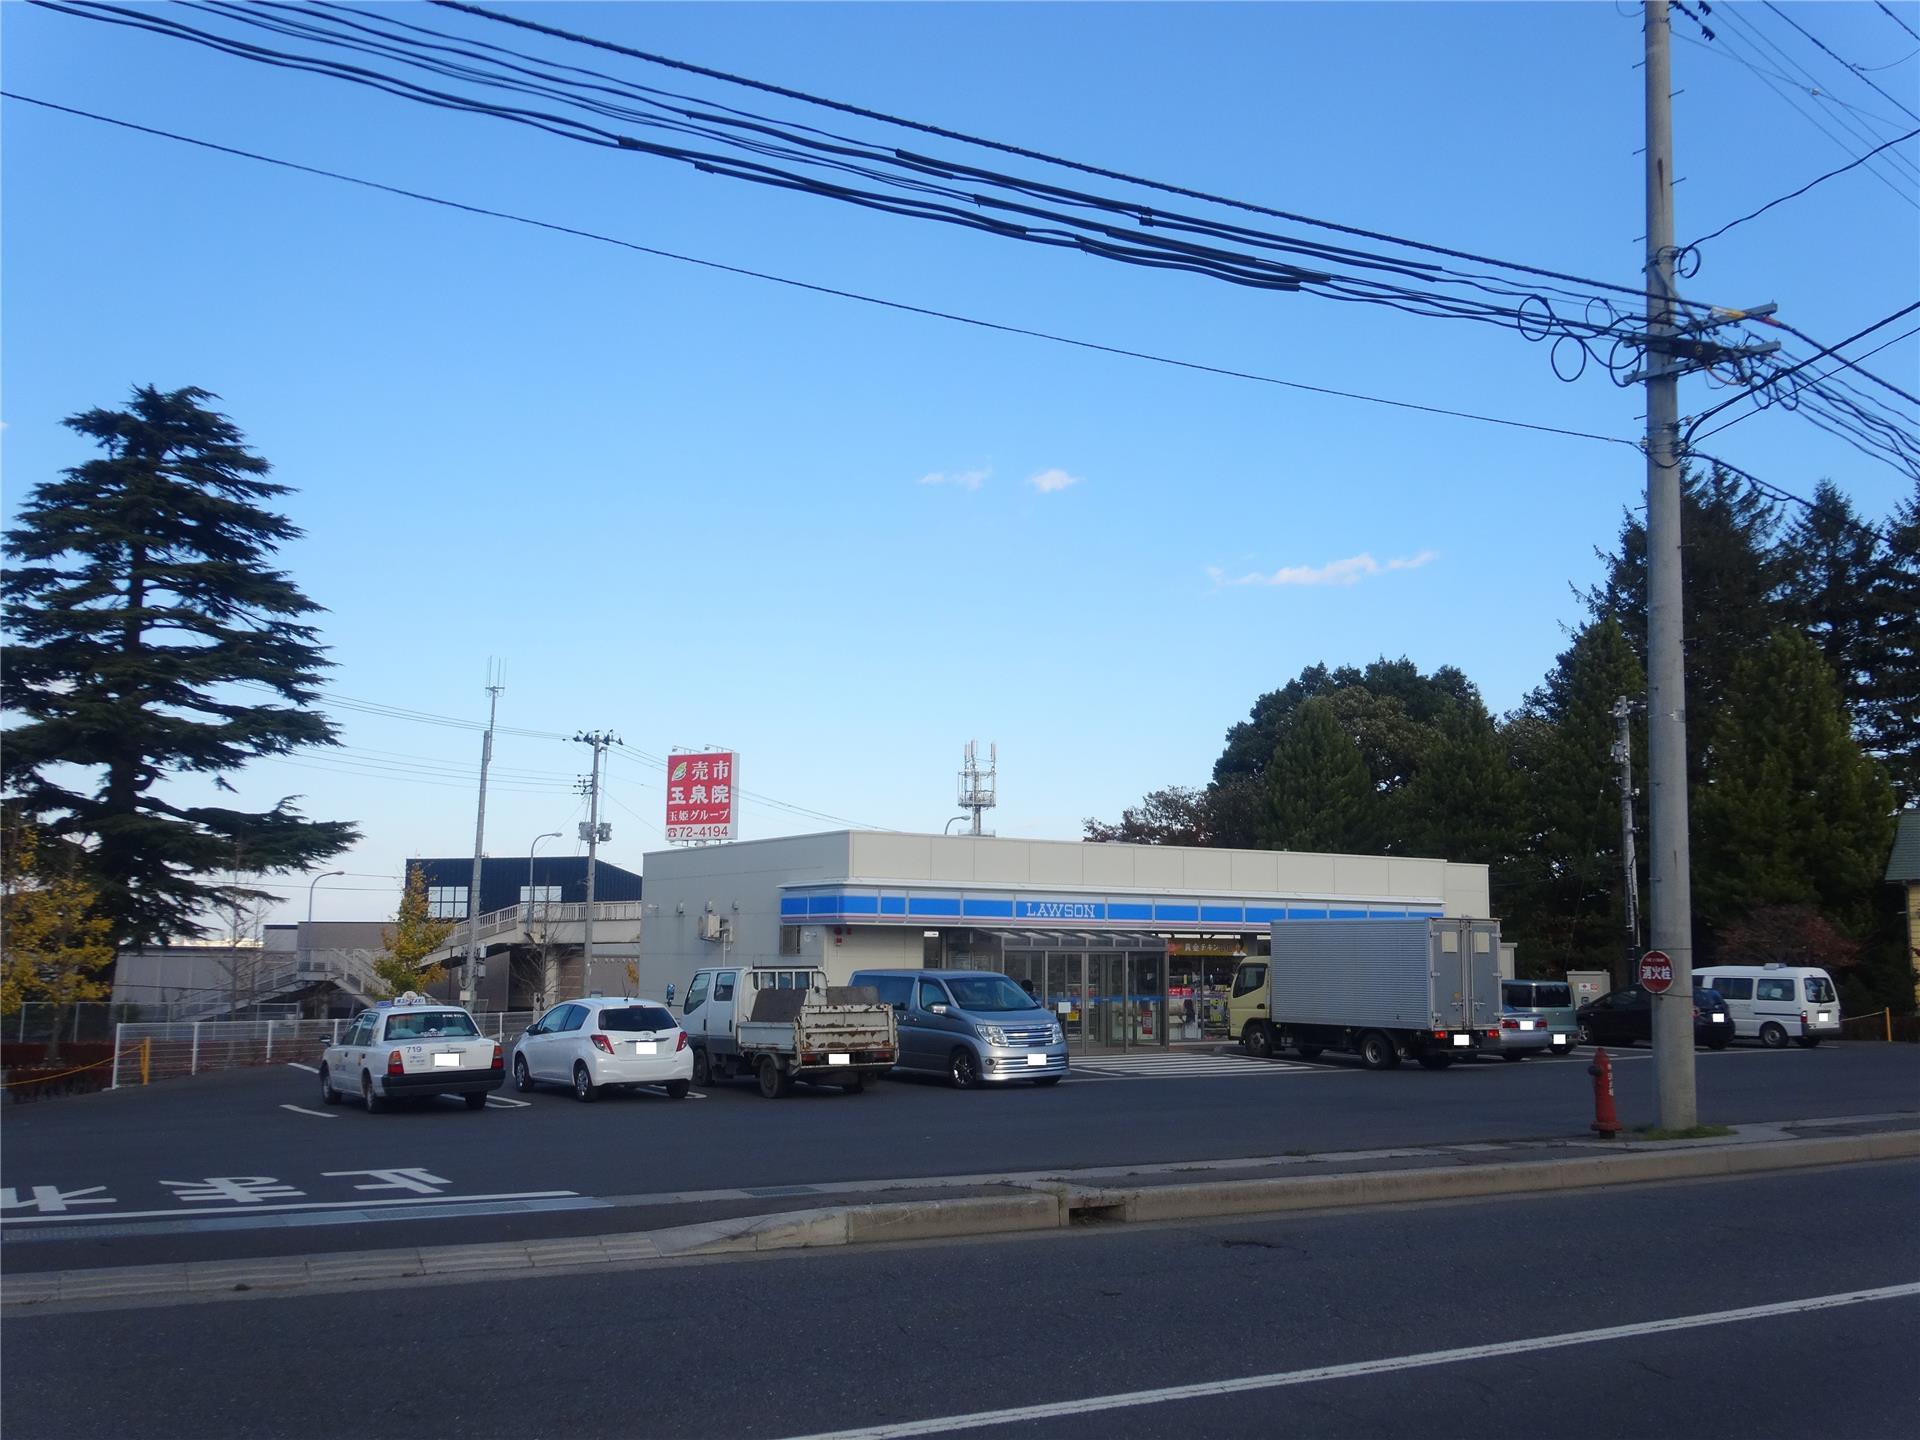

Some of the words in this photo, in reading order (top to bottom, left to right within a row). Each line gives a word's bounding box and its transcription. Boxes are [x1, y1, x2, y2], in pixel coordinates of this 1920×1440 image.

[691, 760, 729, 780] 売市
[668, 785, 729, 804] 玉泉院
[669, 809, 729, 821] 玉姫グループ
[679, 826, 728, 837] 72-4194
[1026, 902, 1096, 918] LAWSON
[1642, 966, 1672, 980] 消火栓
